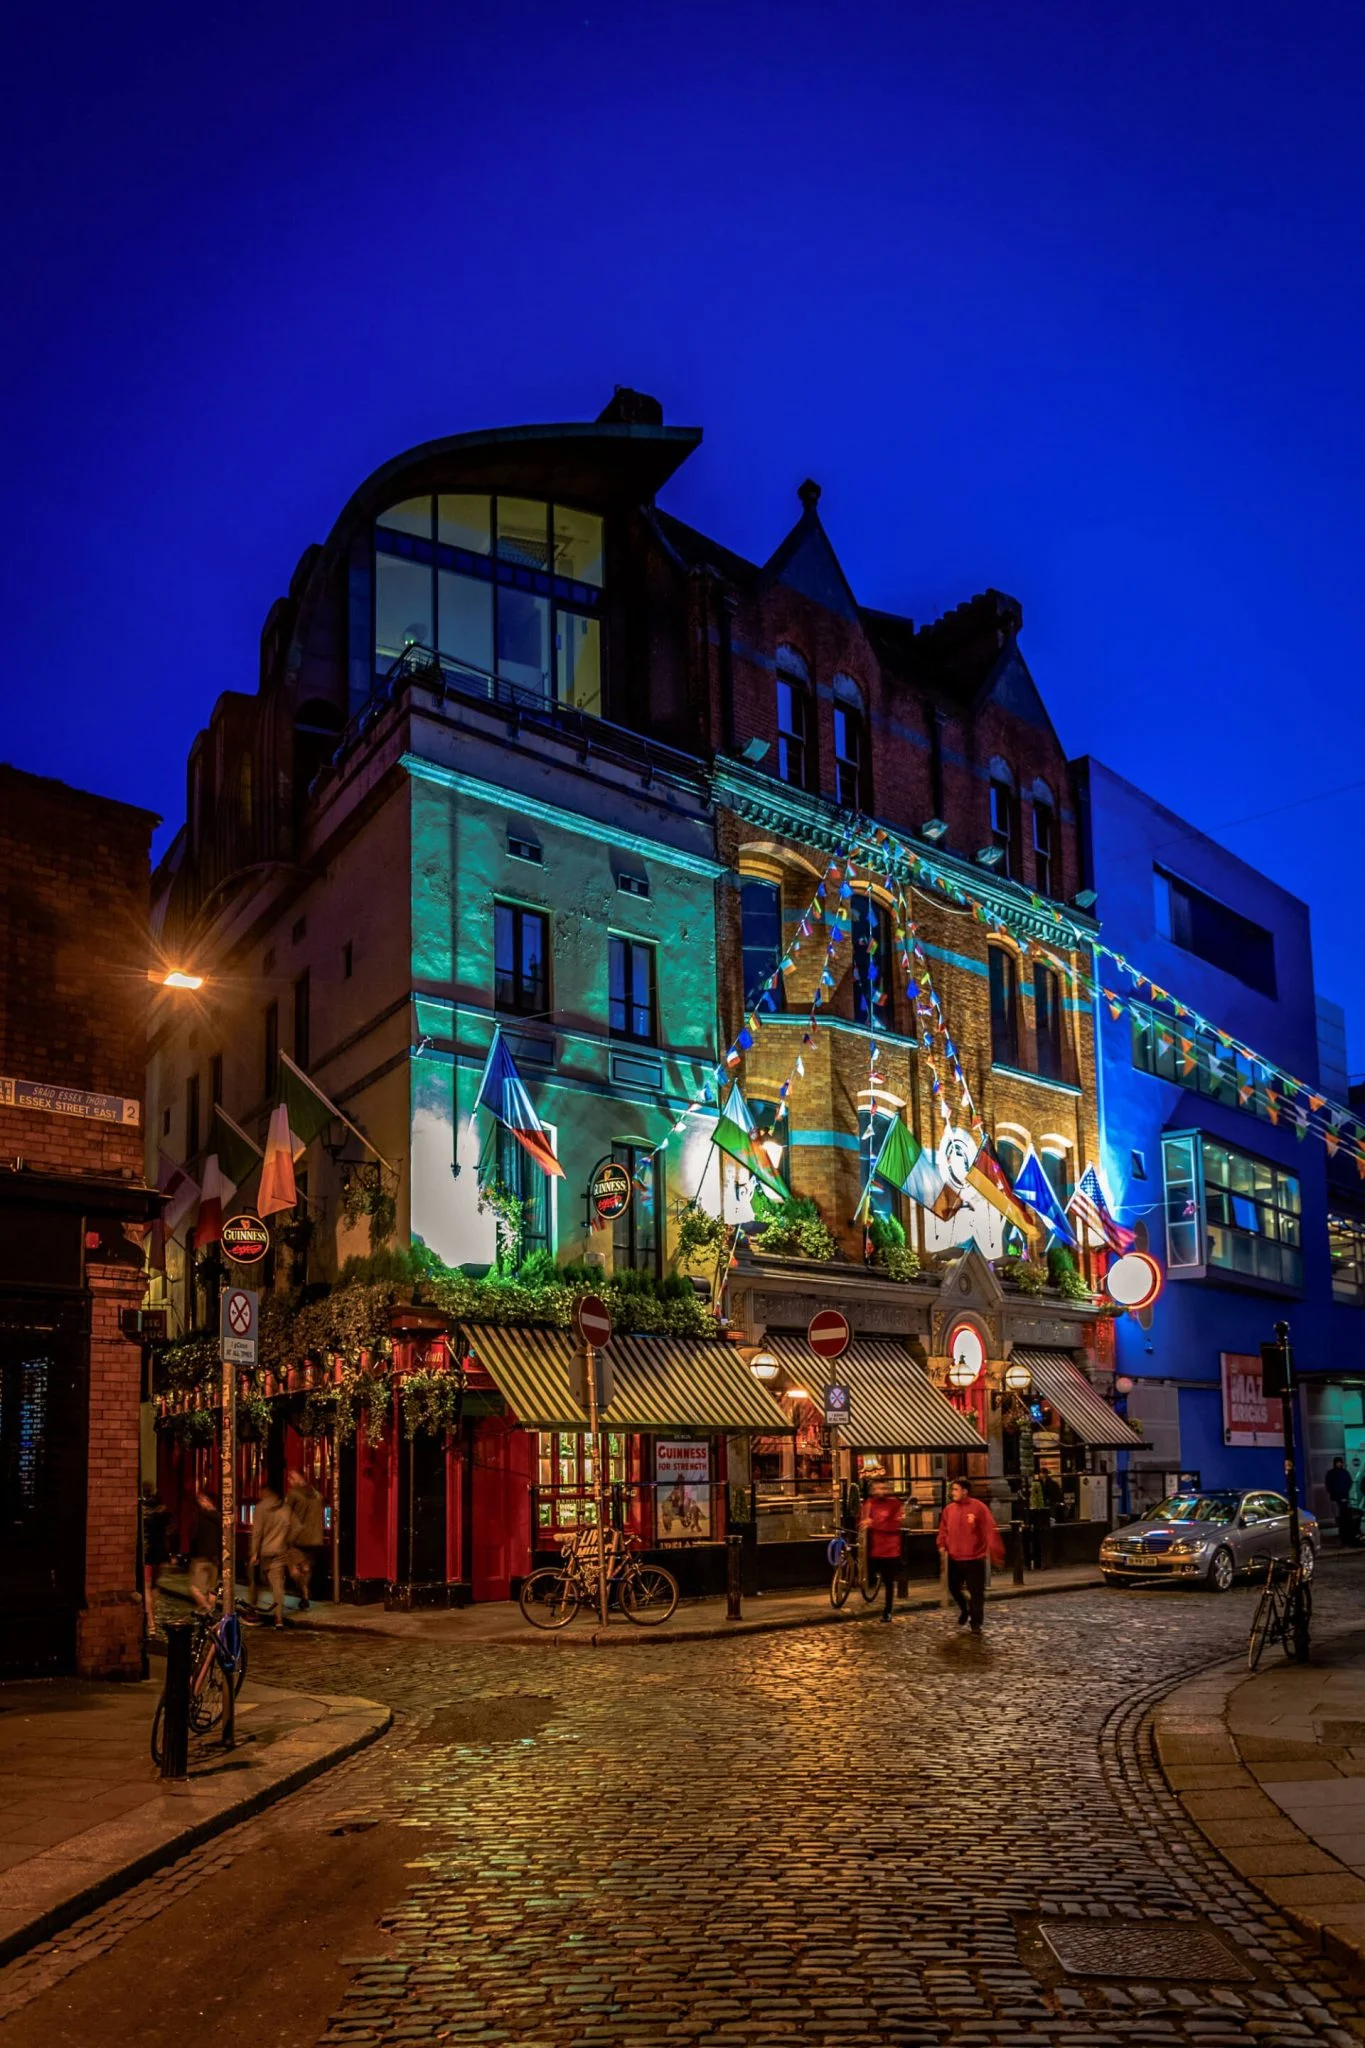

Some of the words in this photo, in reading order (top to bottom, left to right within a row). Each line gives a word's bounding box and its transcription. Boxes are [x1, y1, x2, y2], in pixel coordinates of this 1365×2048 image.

[58, 1091, 84, 1103] ESSEX
[85, 1095, 107, 1106] THOIR
[19, 1094, 52, 1109] ESSEX
[55, 1101, 90, 1115] STREET
[93, 1107, 117, 1119] EAST
[126, 1105, 136, 1118] 2
[223, 1229, 267, 1243] GUINNESS
[1231, 1403, 1269, 1424] BRICKS
[657, 1445, 707, 1460] GUINNESS
[658, 1462, 671, 1471] FOR
[673, 1462, 707, 1472] STRENGTH
